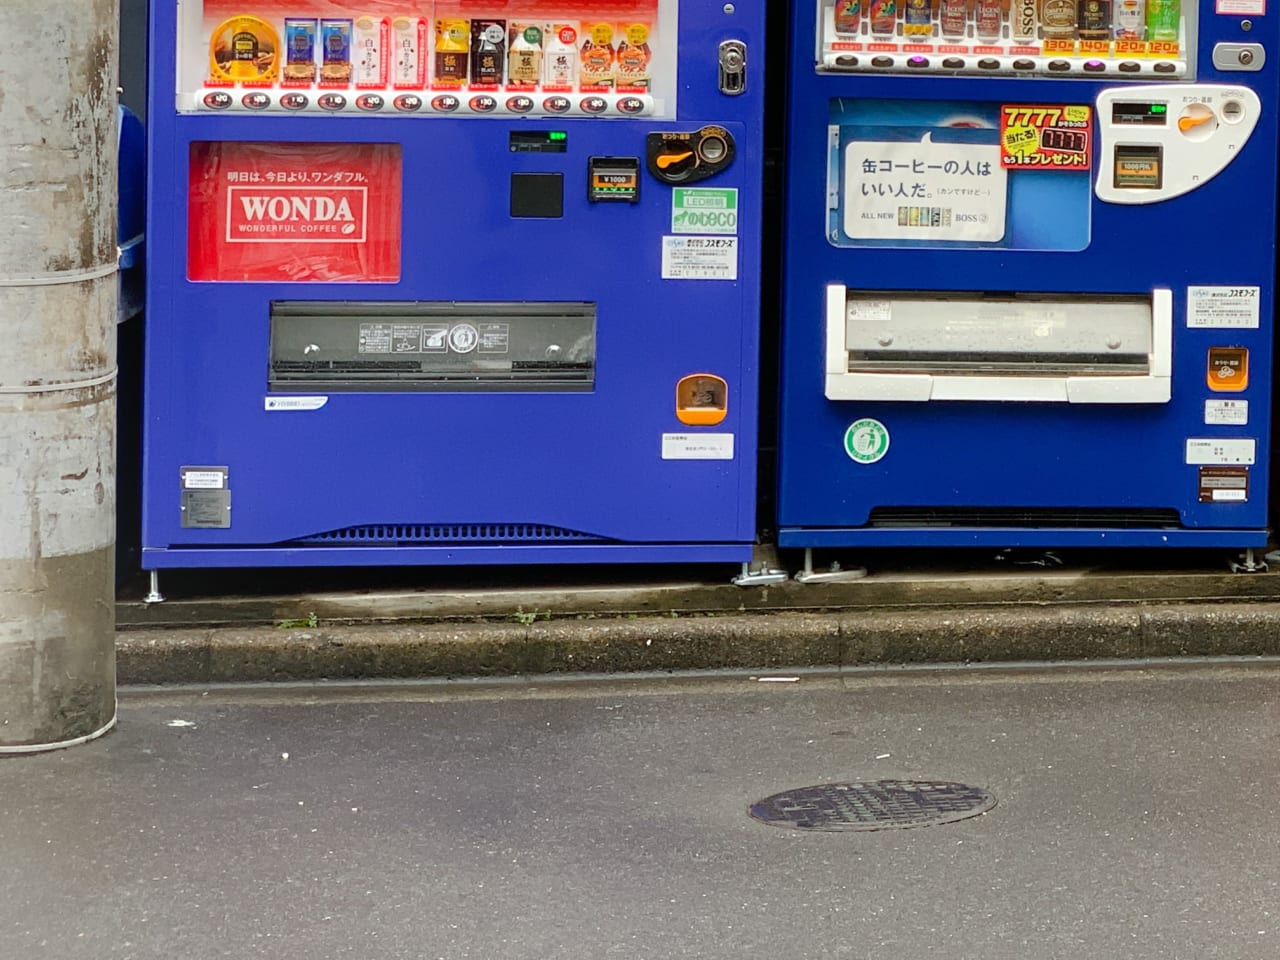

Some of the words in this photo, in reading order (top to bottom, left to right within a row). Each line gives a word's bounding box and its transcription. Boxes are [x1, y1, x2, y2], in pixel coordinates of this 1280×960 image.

[1045, 41, 1075, 50] 130円
[1079, 42, 1109, 51] 140円
[1116, 42, 1145, 51] 120円
[1150, 42, 1179, 52] 120円
[1005, 108, 1062, 127] 7777
[1006, 128, 1037, 144] 当たる!
[1004, 150, 1087, 165] もう1本プレゼント!
[862, 158, 992, 176] 缶コーヒーの人は
[227, 171, 369, 183] 明日は、今日より、ワンダフル。
[862, 182, 932, 199] いい人だ。
[240, 196, 355, 221] WONDA
[955, 214, 978, 222] BOSS
[238, 224, 296, 233] WONDERFUL
[300, 224, 337, 233] COFFEE
